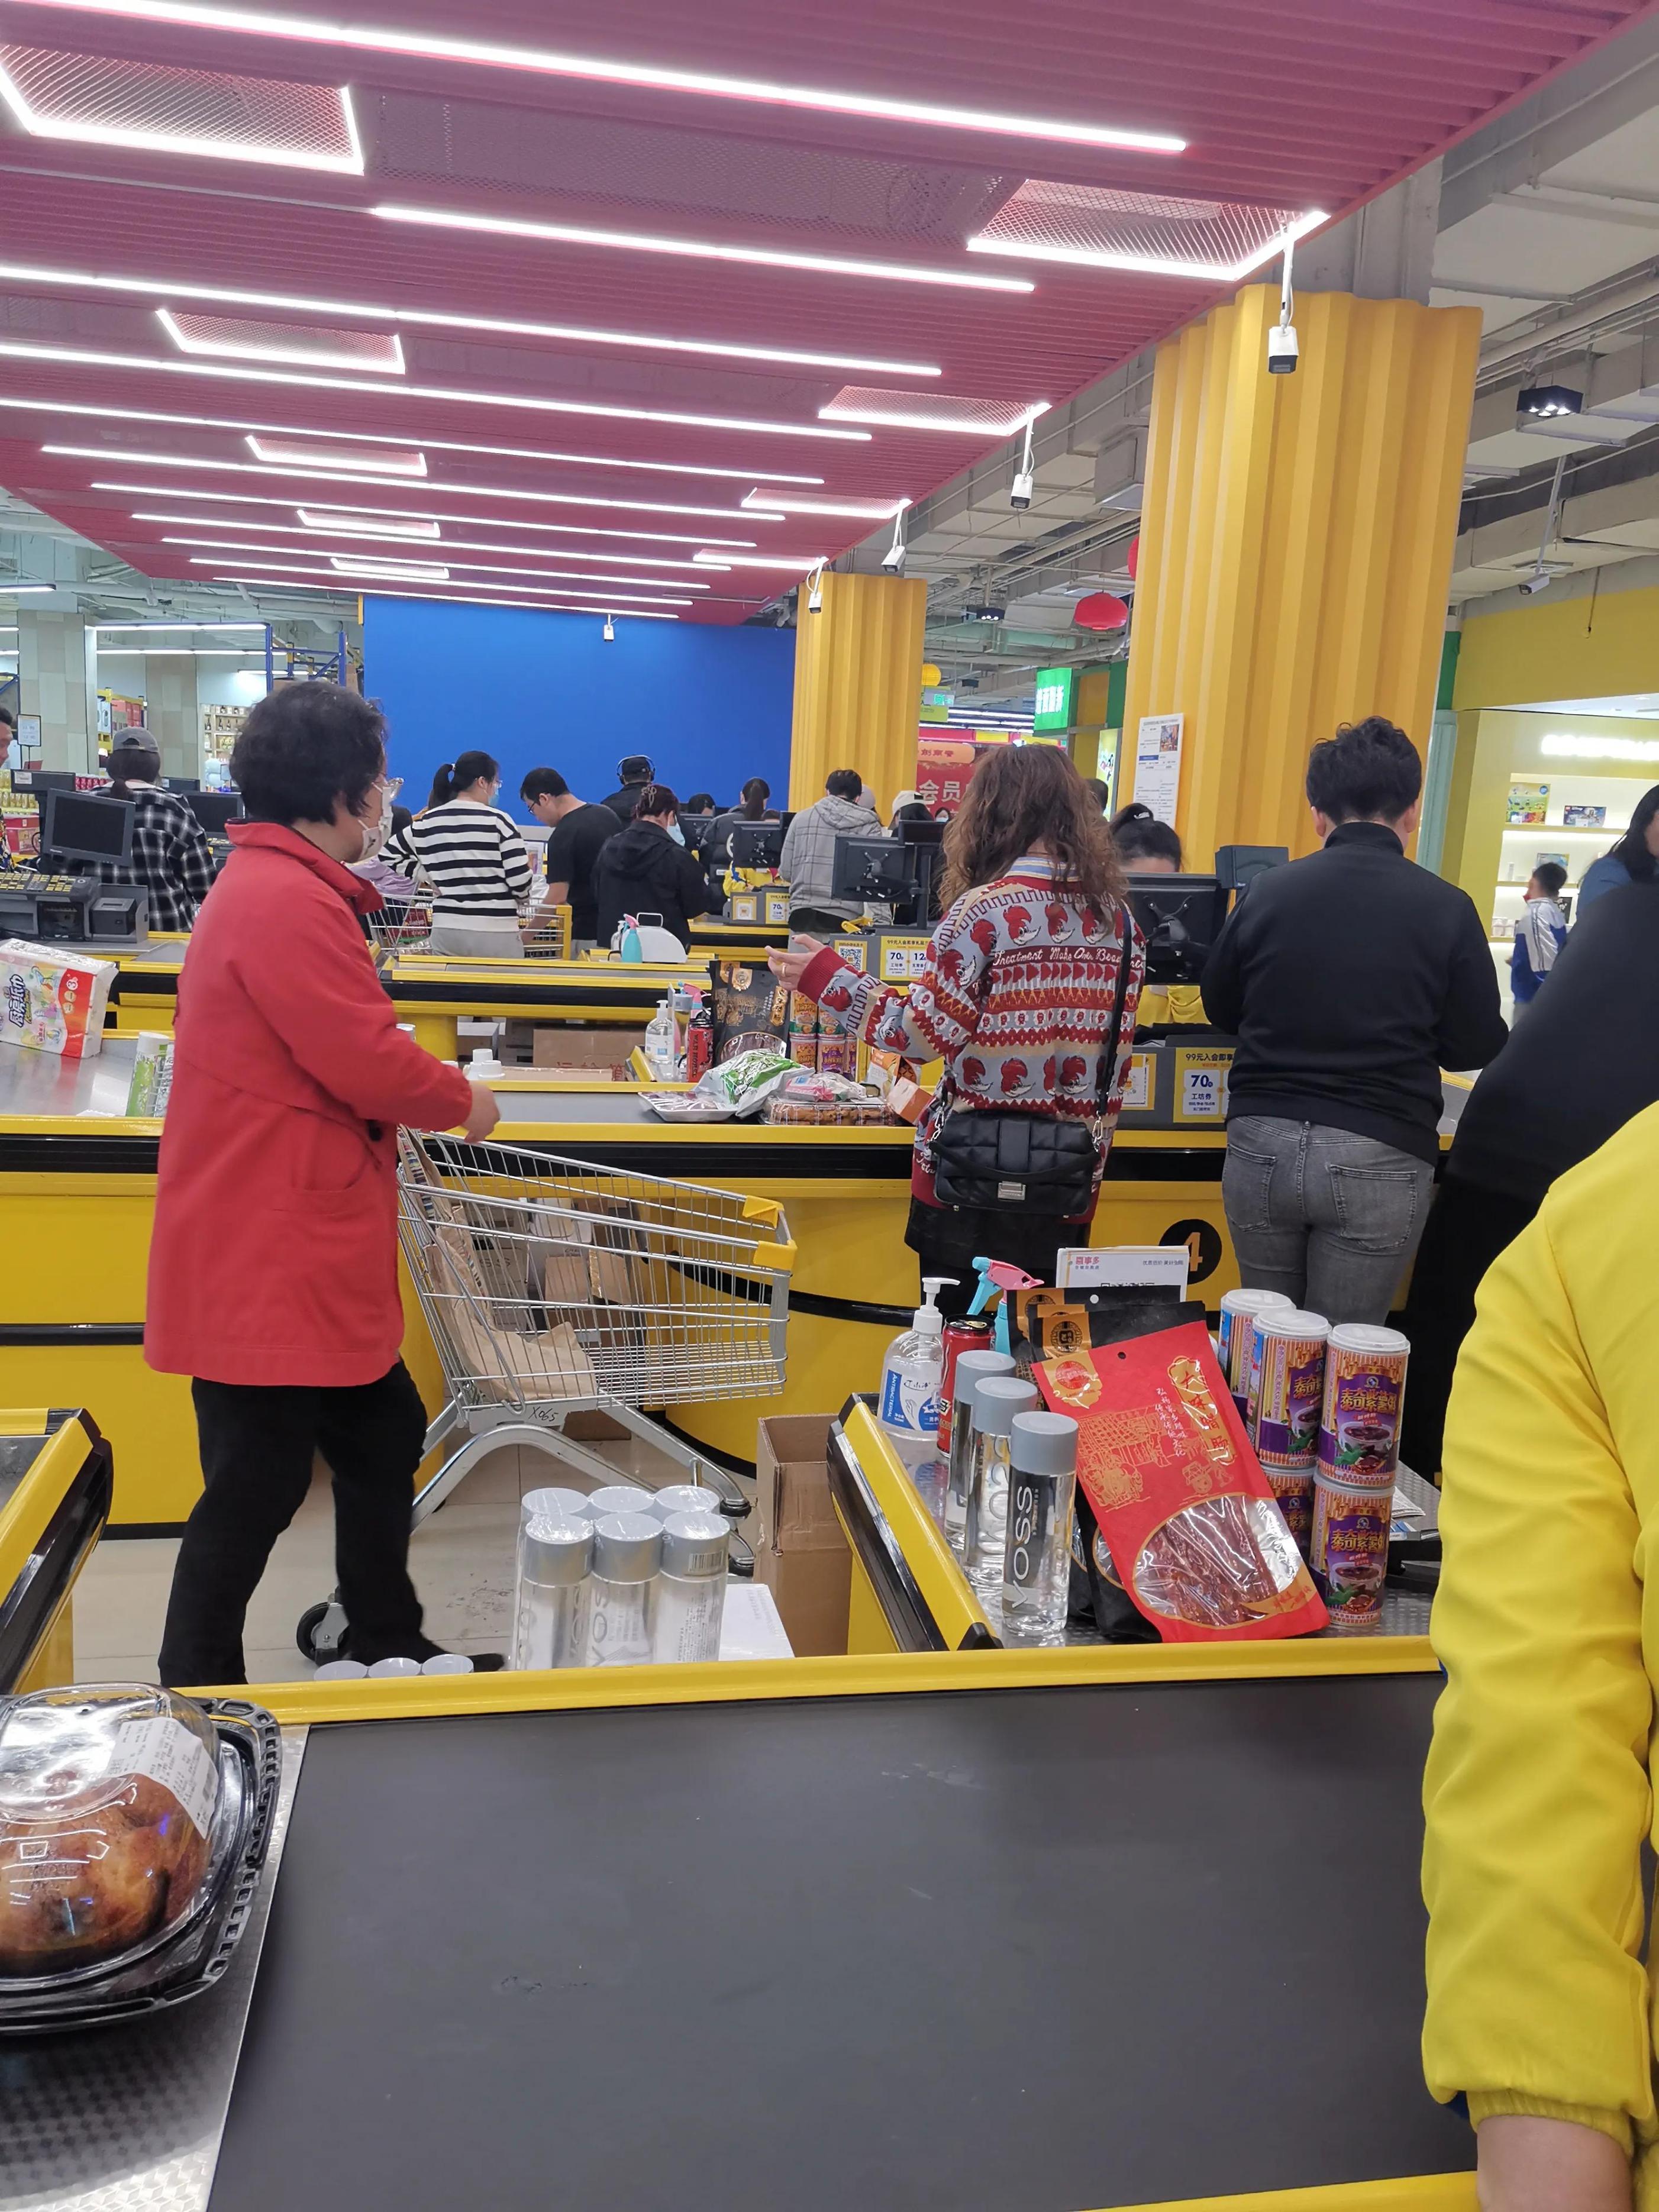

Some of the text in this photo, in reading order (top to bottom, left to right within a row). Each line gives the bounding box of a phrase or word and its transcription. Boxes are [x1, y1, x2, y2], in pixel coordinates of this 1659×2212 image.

[993, 949, 1043, 965] Treatment
[9, 974, 25, 1028] 厨房纸巾
[1184, 1232, 1203, 1271] 4
[1012, 1486, 1032, 1609] VOSS
